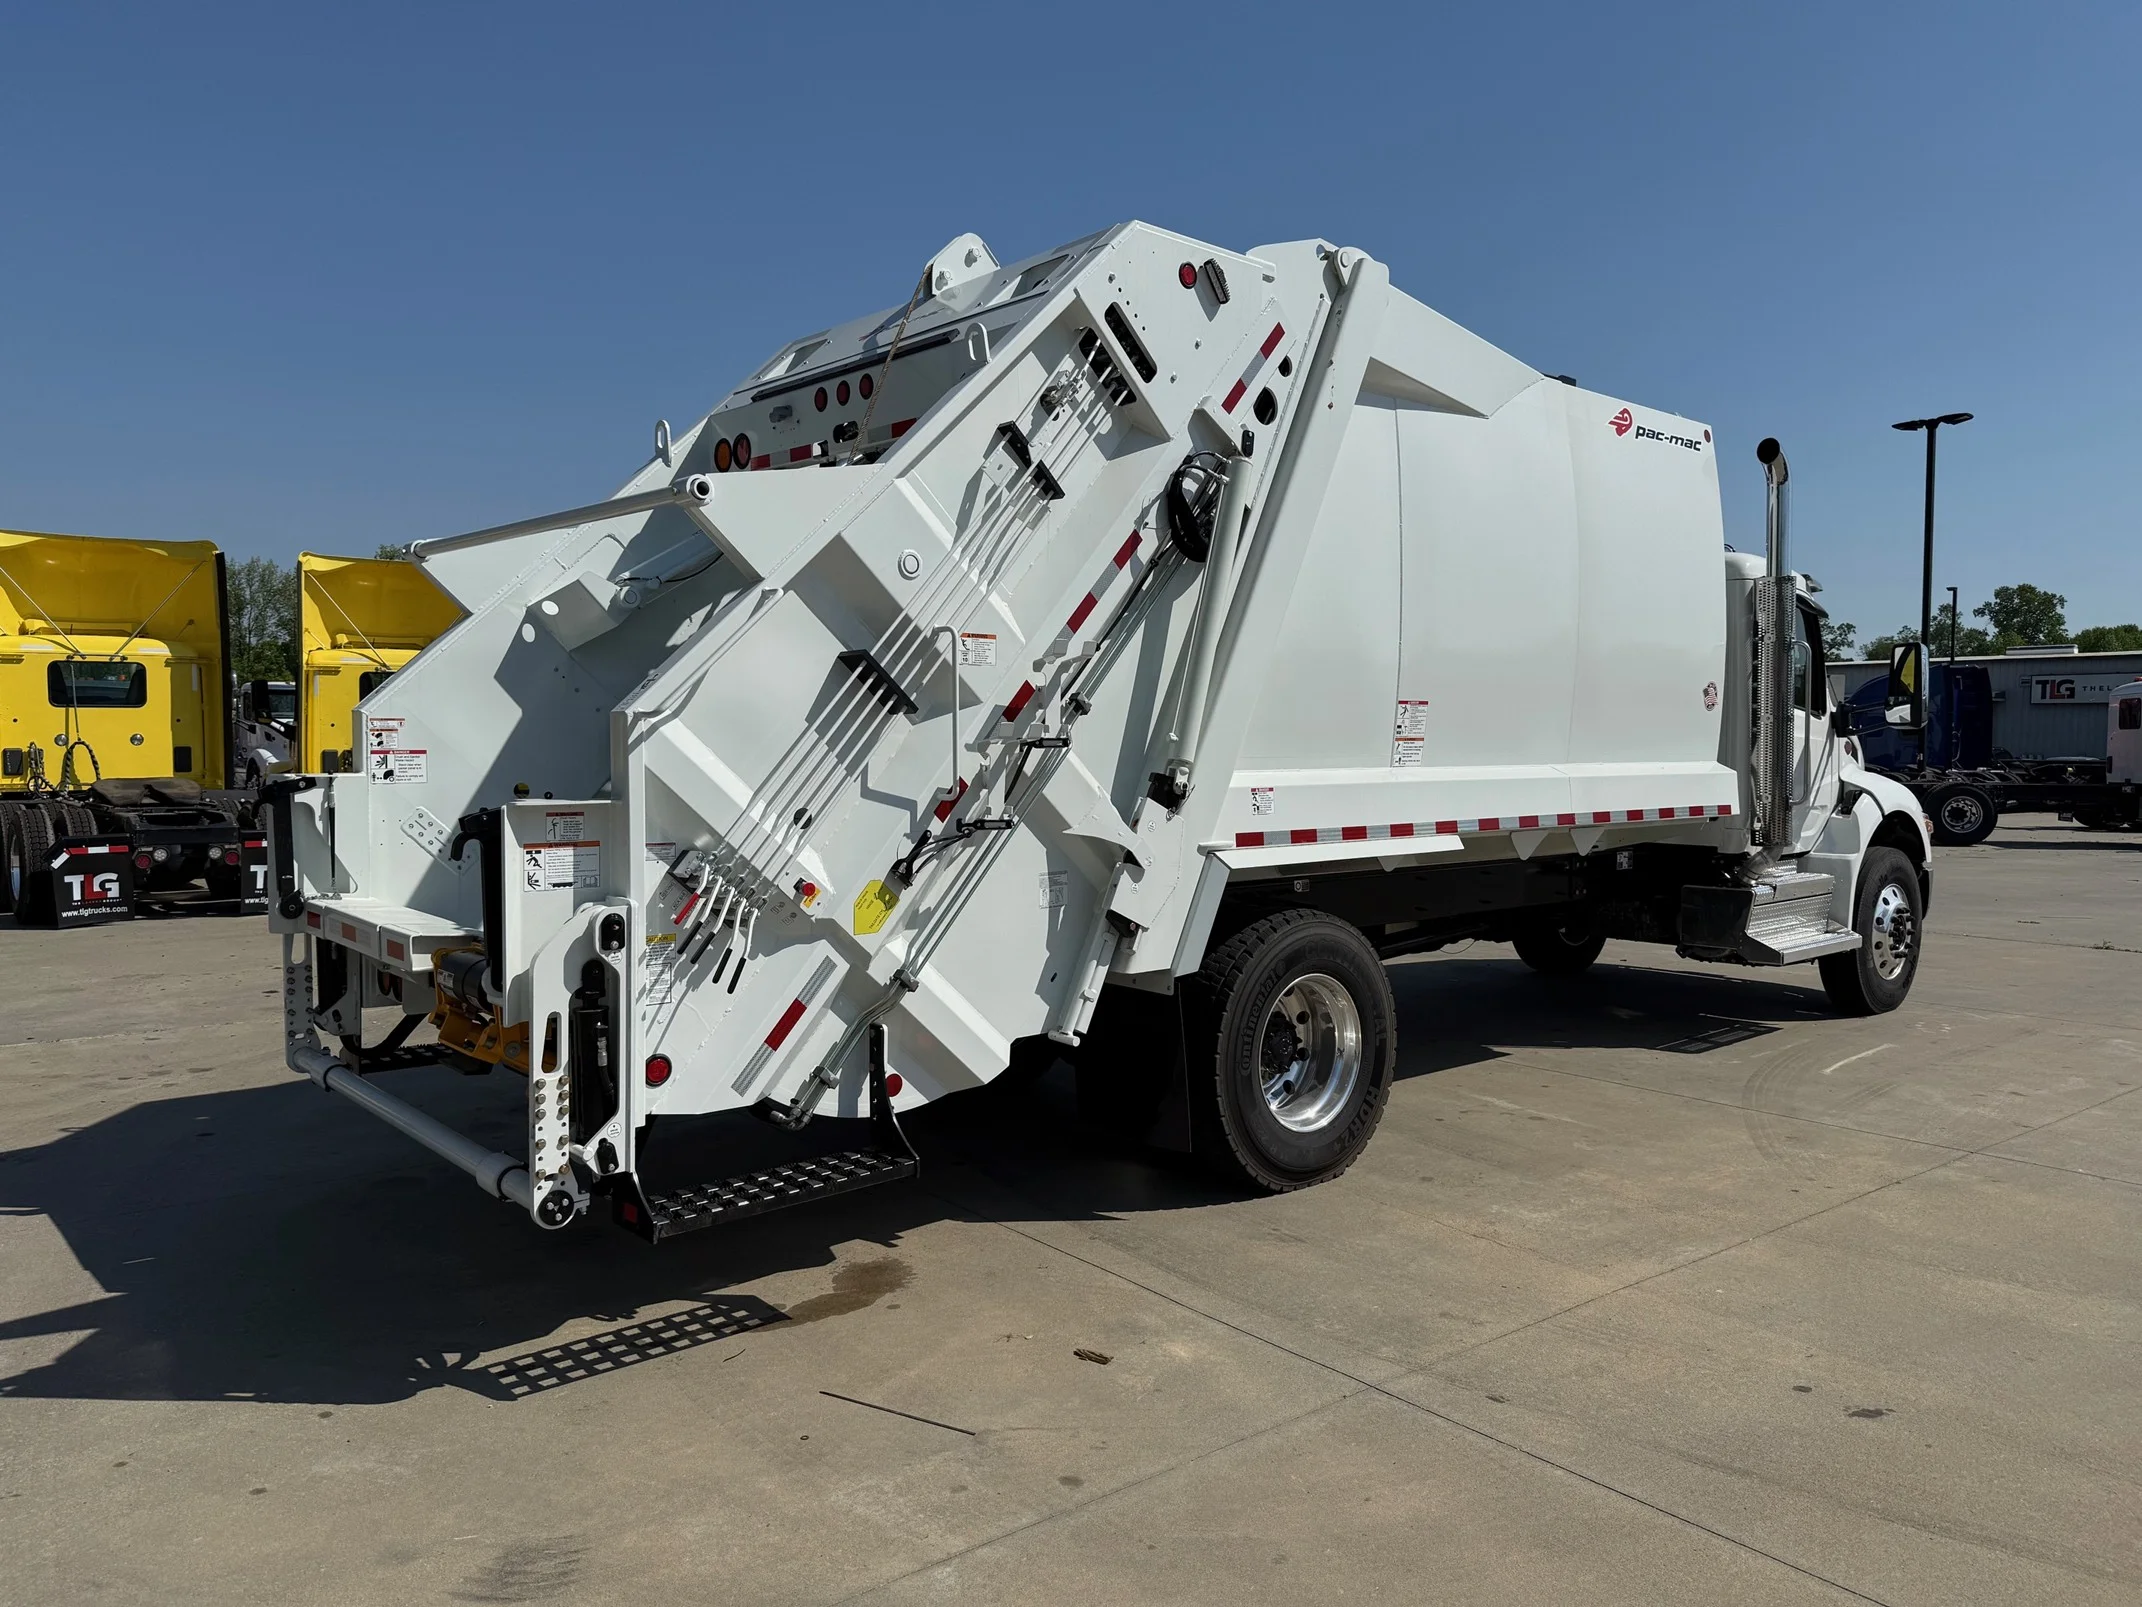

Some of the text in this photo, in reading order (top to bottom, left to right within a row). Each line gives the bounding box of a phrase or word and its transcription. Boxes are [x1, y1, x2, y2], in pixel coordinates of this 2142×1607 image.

[1635, 425, 1702, 452] pac-mac
[2035, 679, 2076, 700] TLG
[64, 872, 120, 901] TLG
[61, 905, 128, 918] www.tlgtrucks.com
